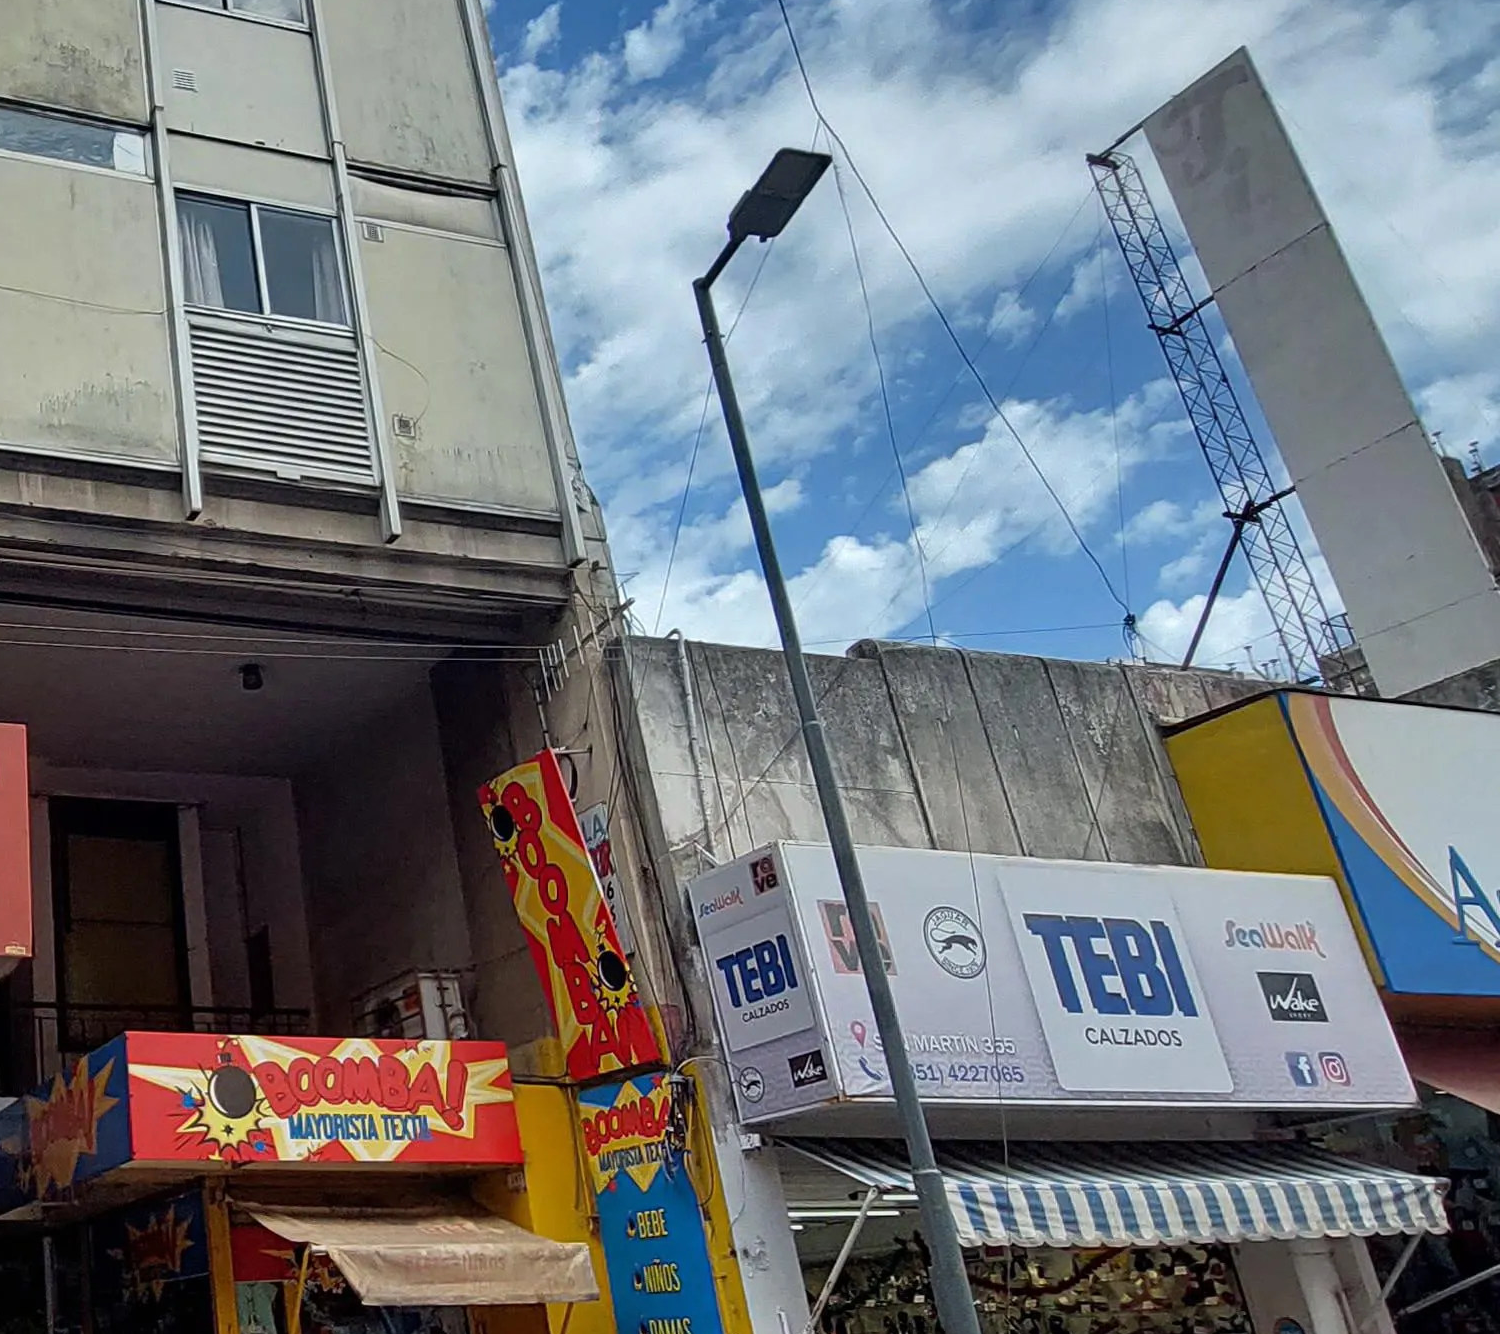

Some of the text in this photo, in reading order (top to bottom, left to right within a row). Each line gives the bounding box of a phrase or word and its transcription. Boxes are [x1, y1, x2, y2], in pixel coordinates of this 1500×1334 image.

[1224, 919, 1327, 959] SeaWalk
[716, 933, 799, 1009] TEBI
[1022, 913, 1199, 1018] TEBI
[741, 998, 790, 1023] CALZADOS
[1269, 976, 1320, 1012] Wake
[982, 1036, 1016, 1055] 355
[1084, 1027, 1183, 1048] CALZADOS
[948, 1063, 1025, 1083] 4227065
[253, 1054, 468, 1131] BOOMBA!
[288, 1113, 380, 1141] MAYORISTA
[636, 1208, 669, 1240] BEBE
[643, 1258, 682, 1293] NIÑOS
